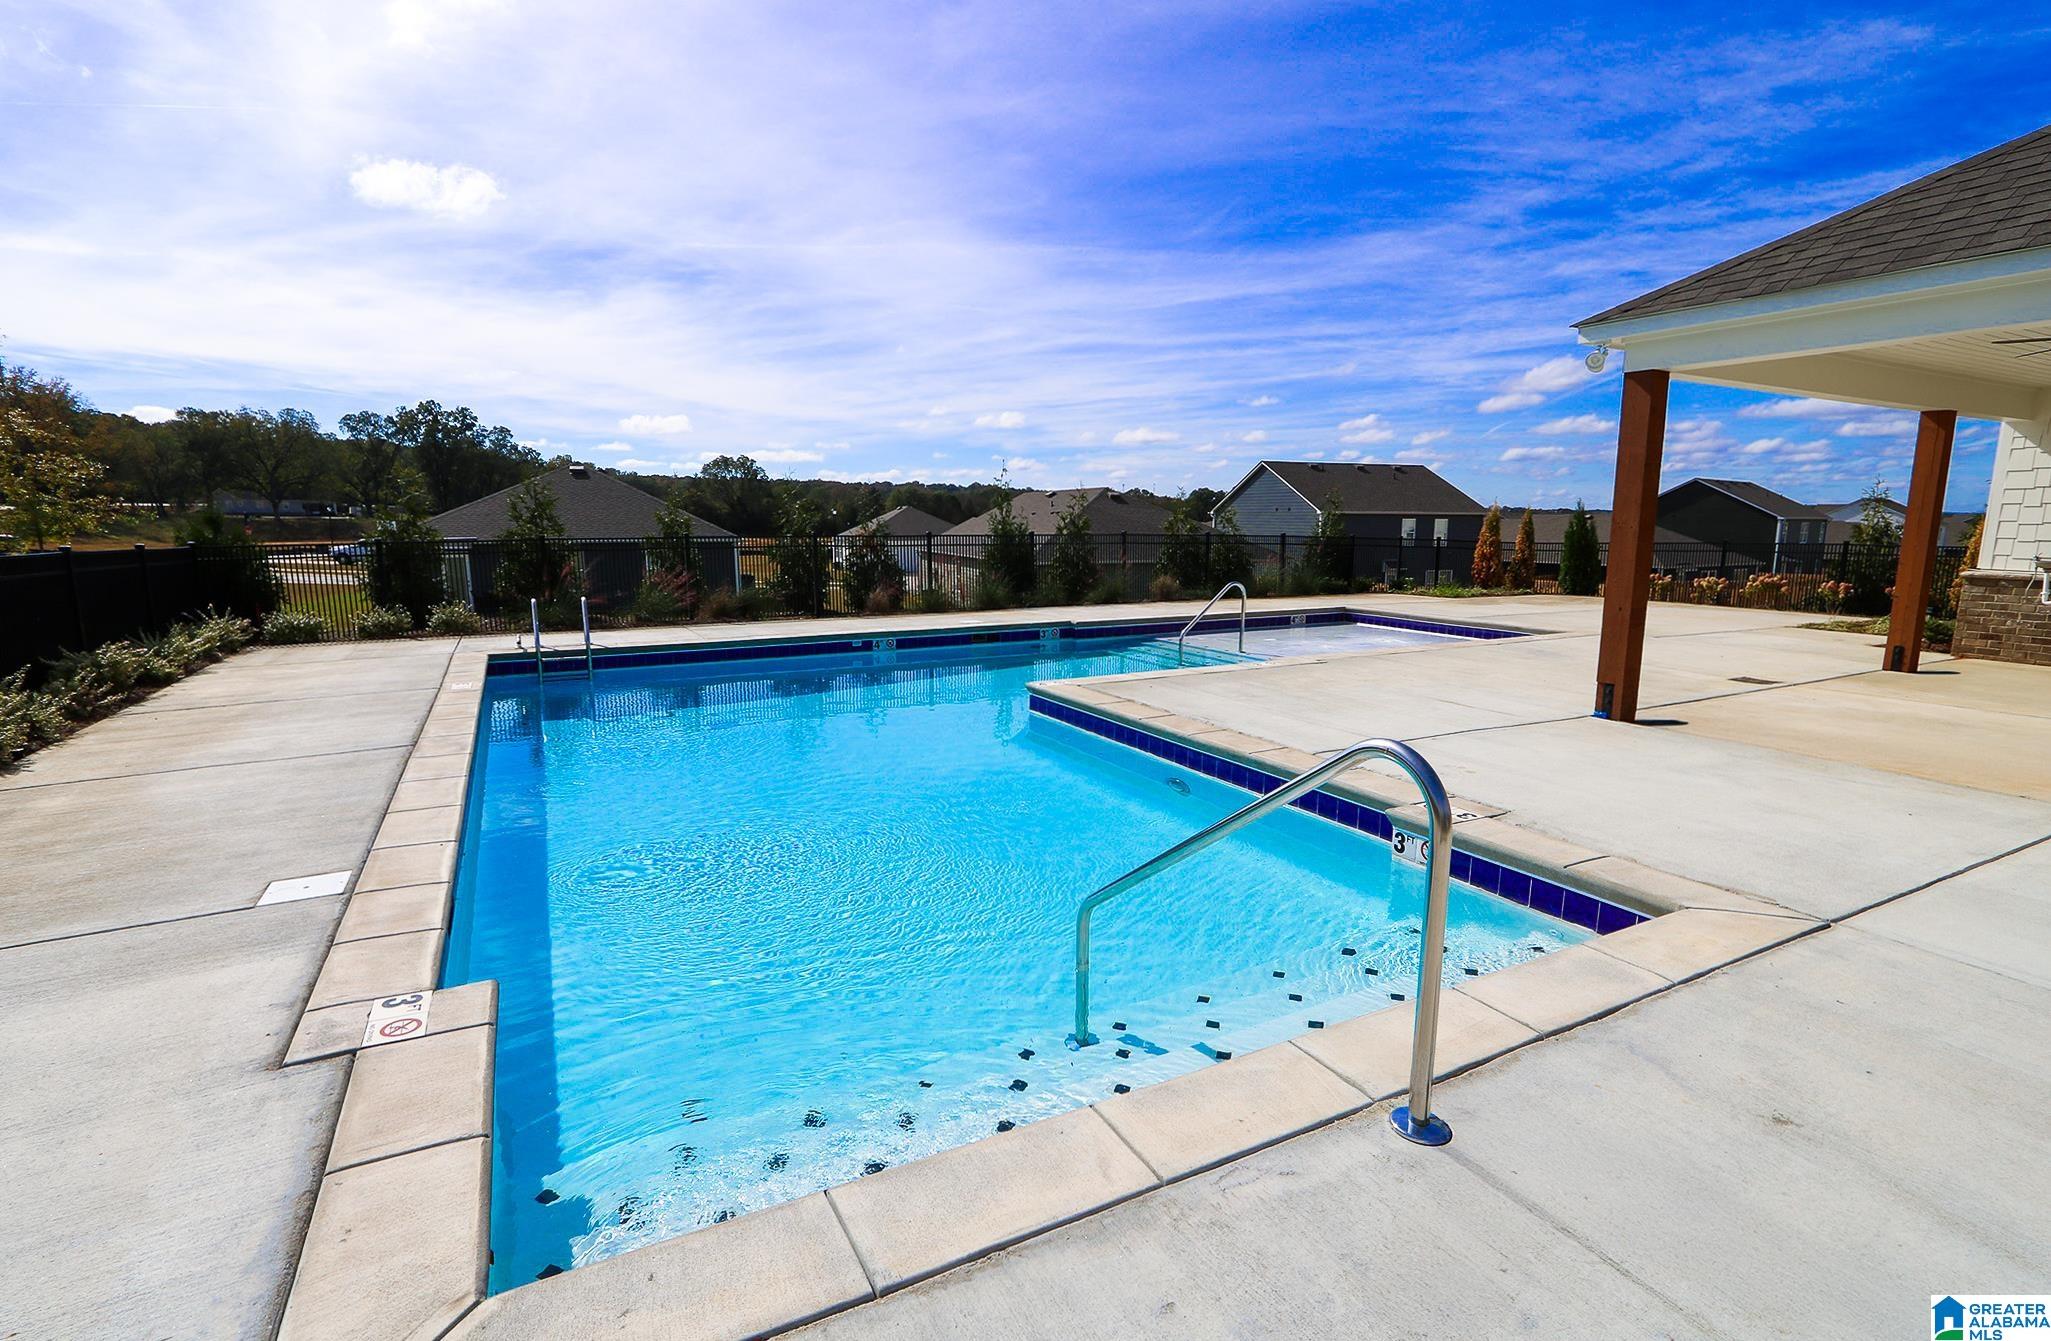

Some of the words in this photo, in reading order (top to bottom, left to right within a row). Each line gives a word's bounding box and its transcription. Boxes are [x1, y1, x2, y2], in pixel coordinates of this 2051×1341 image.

[1393, 831, 1406, 854] 3
[1406, 835, 1416, 845] FT
[381, 994, 423, 1009] 3
